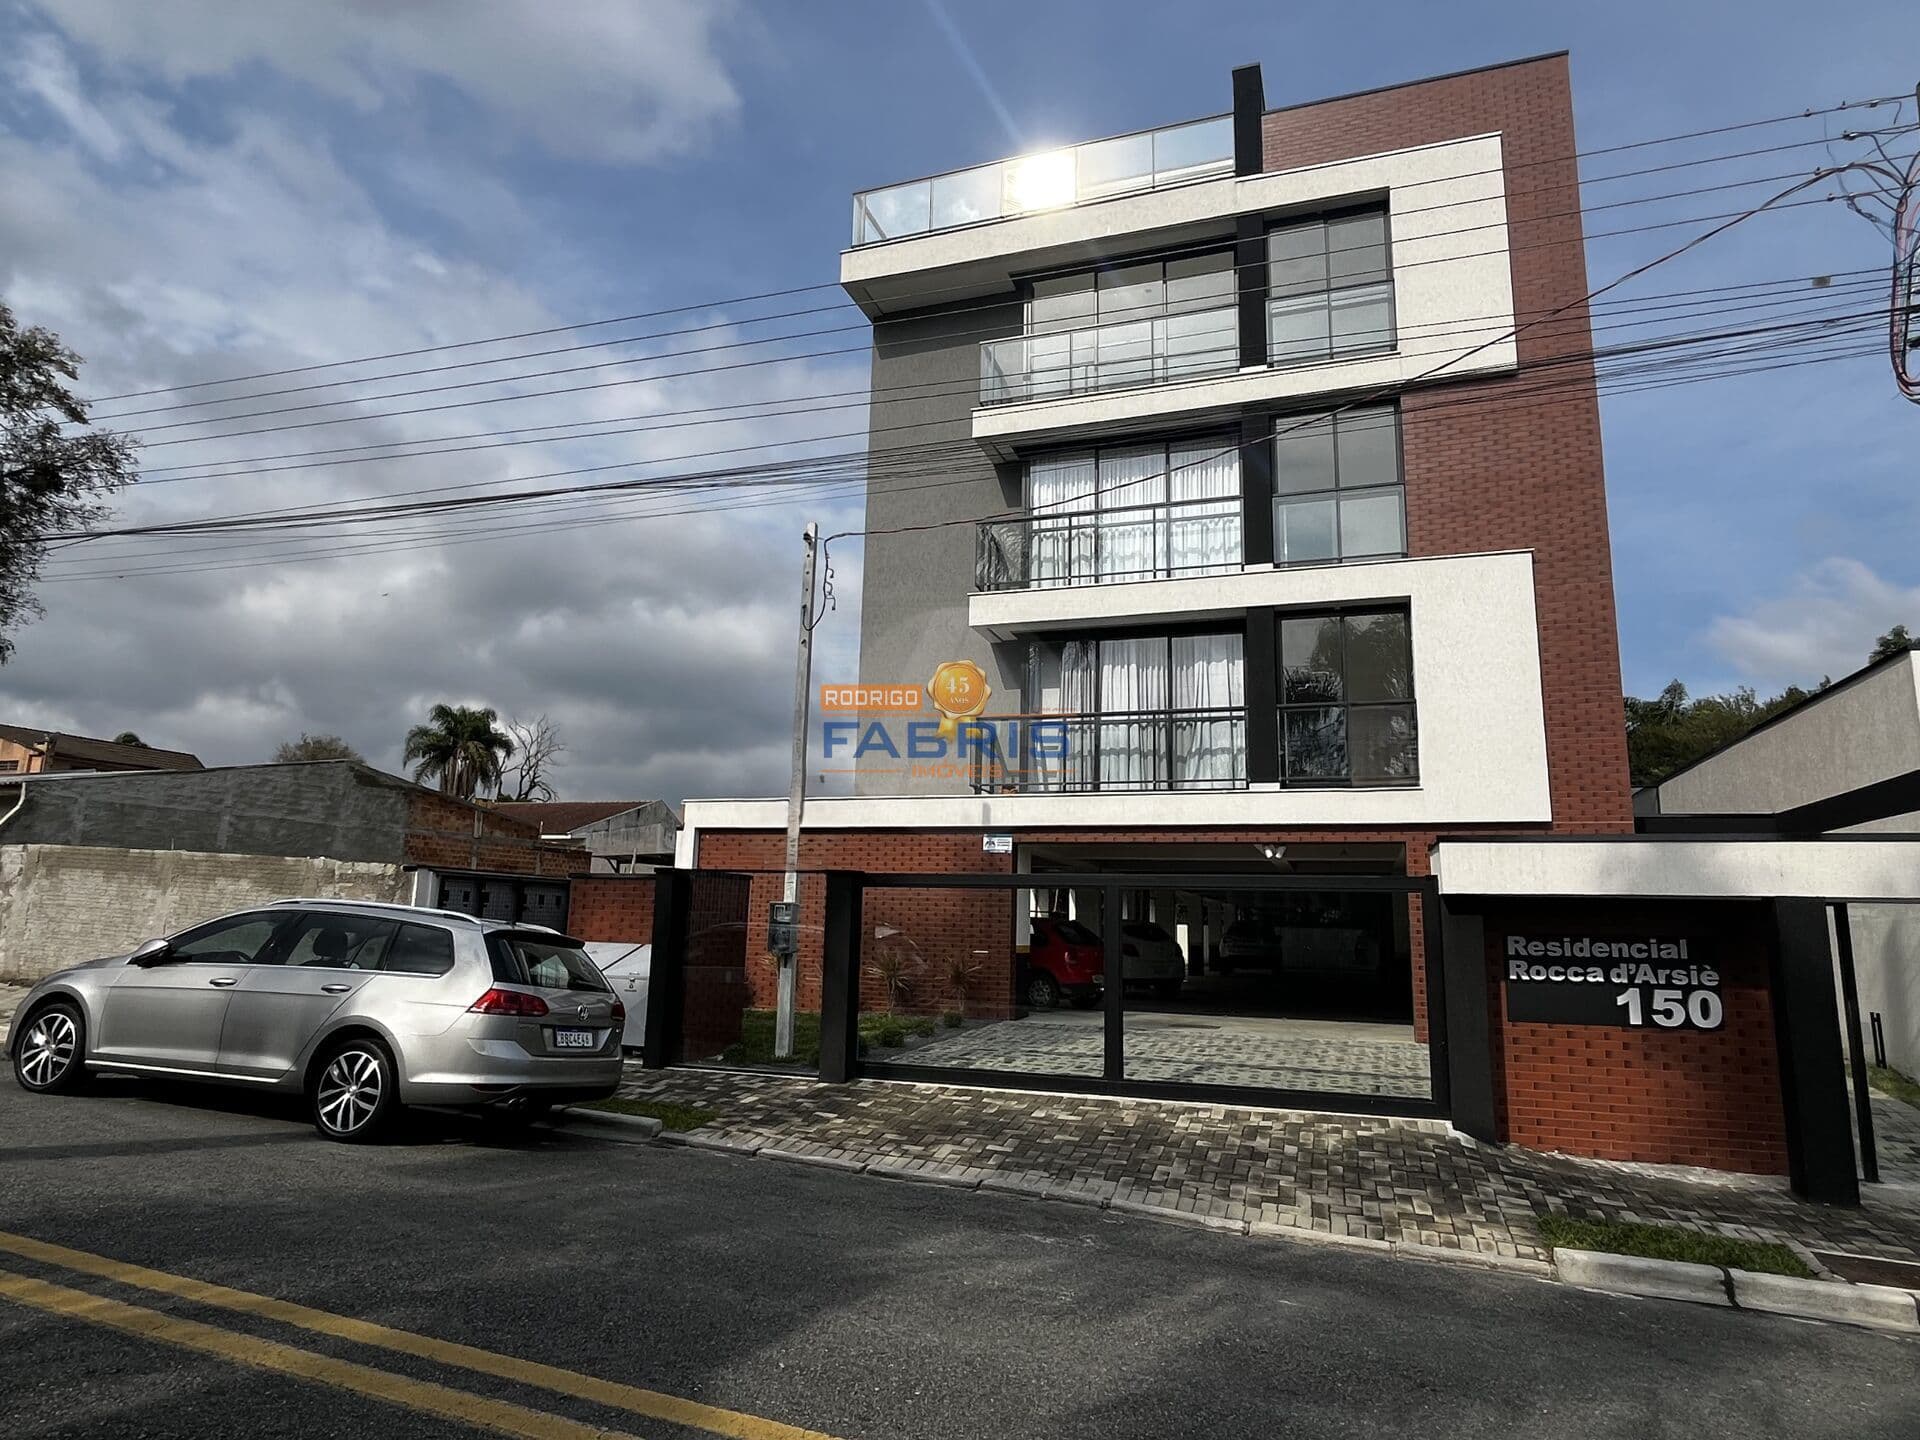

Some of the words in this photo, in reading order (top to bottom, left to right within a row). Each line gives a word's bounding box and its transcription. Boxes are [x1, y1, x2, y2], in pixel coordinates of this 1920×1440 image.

[1507, 936, 1688, 960] Residencial
[1509, 960, 1605, 983] Rocca
[1610, 963, 1720, 987] d'Arsiè
[1616, 987, 1723, 1029] 150
